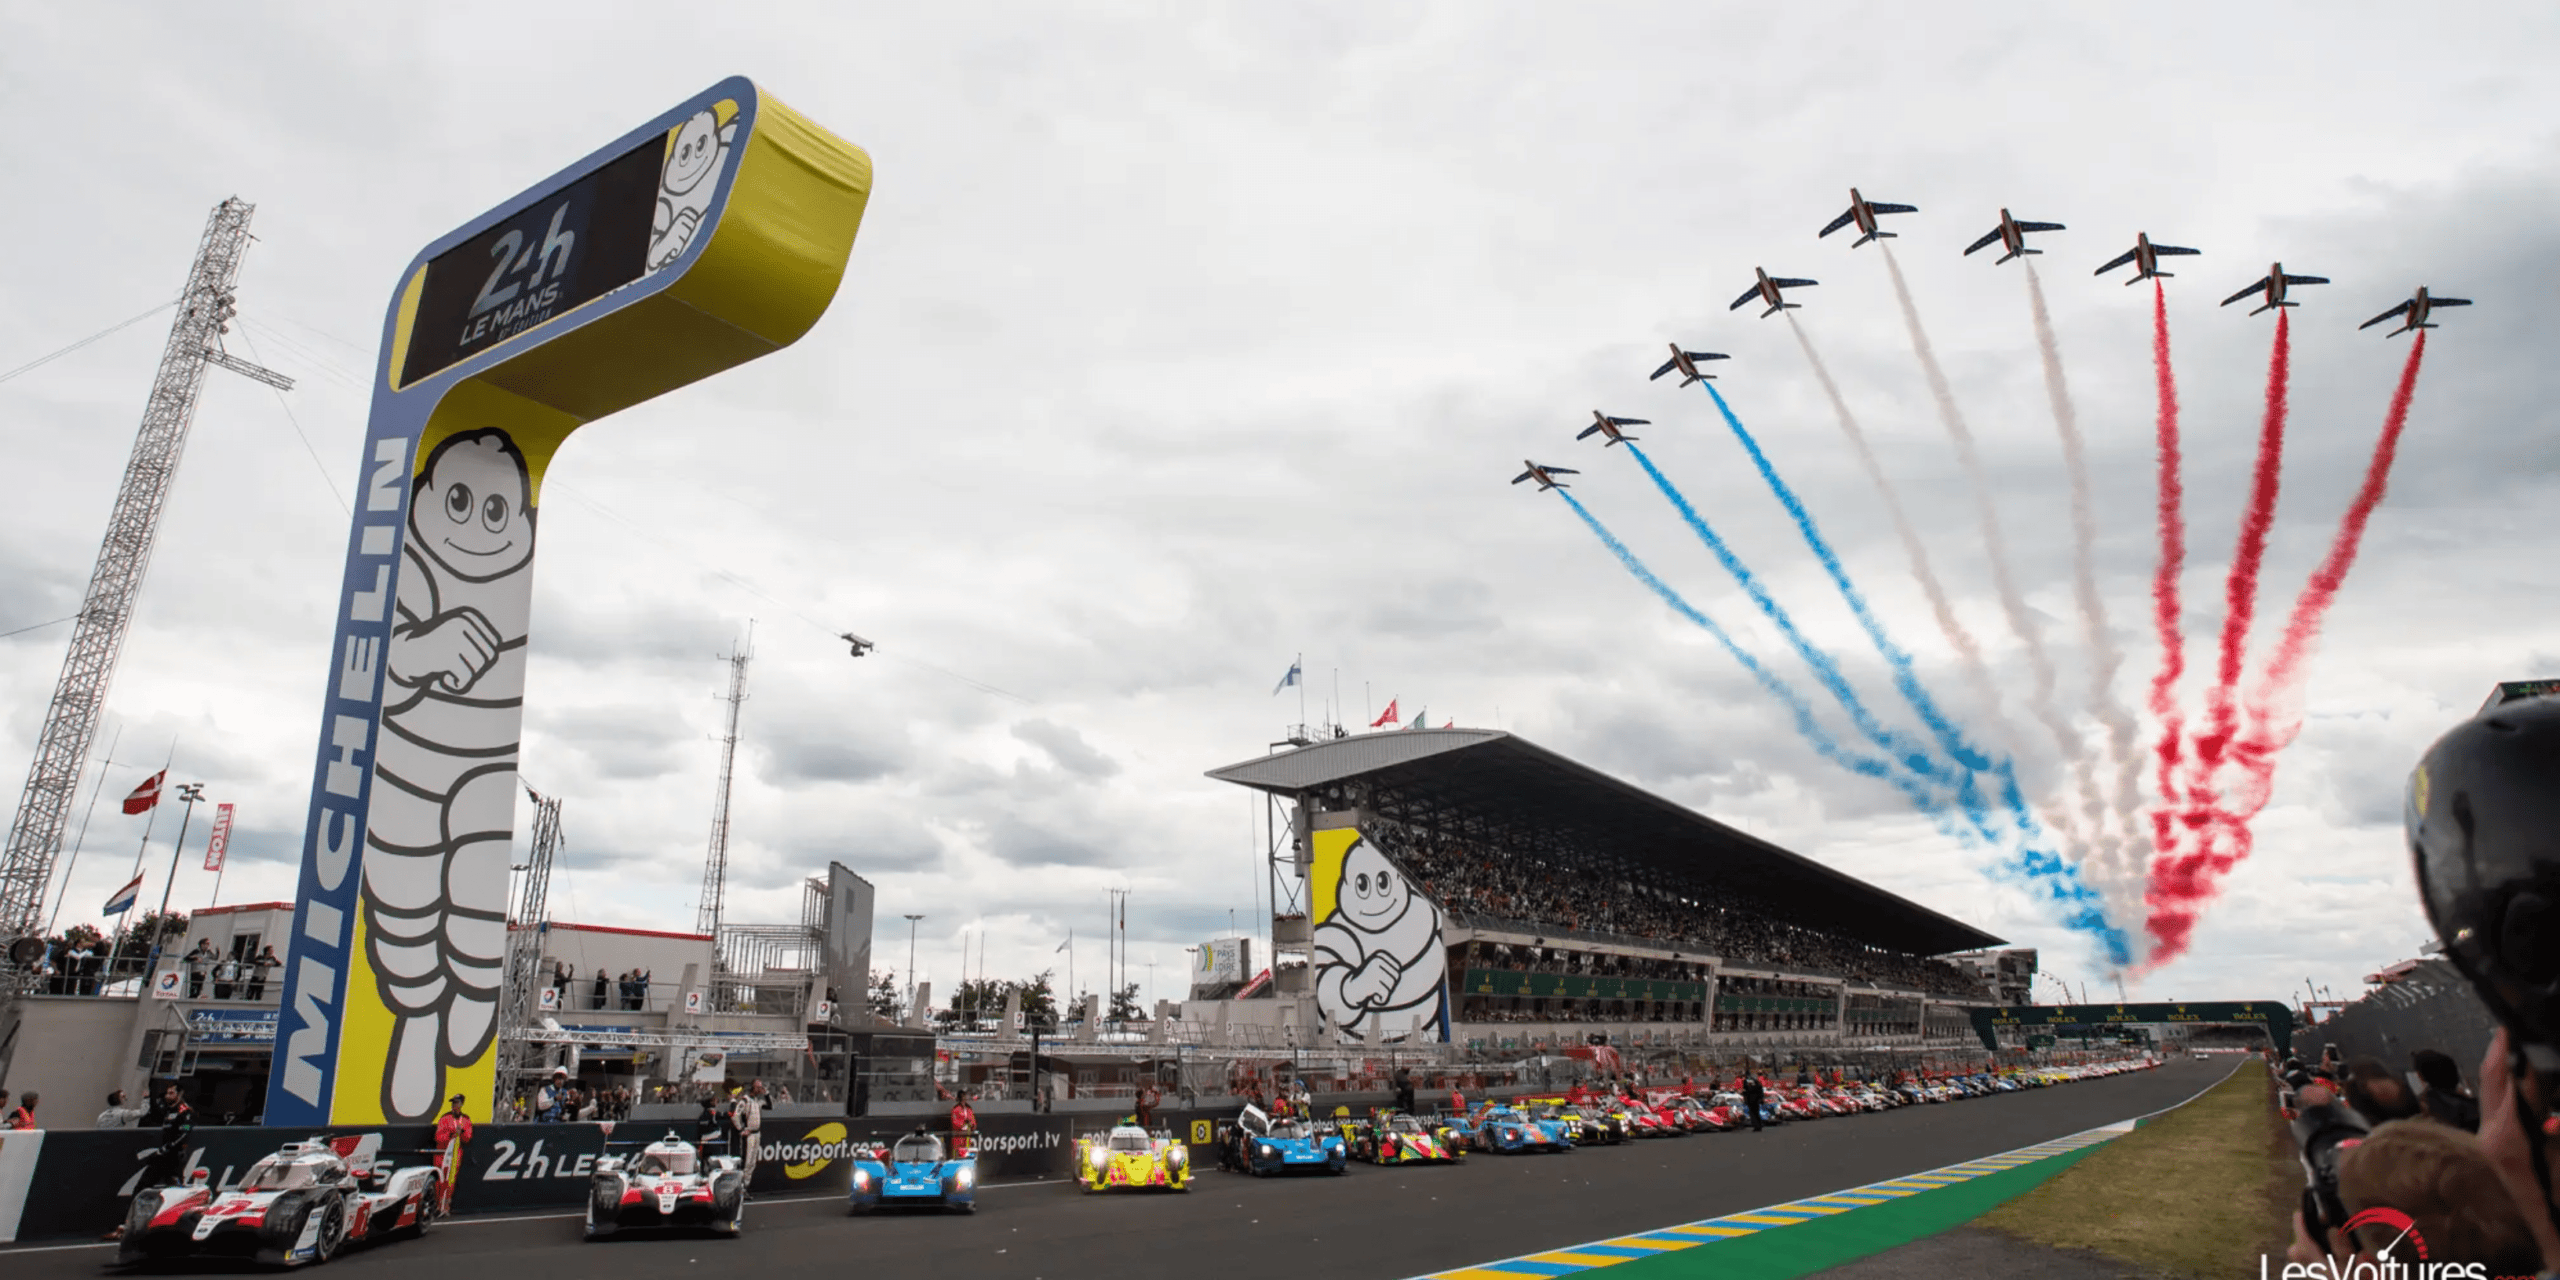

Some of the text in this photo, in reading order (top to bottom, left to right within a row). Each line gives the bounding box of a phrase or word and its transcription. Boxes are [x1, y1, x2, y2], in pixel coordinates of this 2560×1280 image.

[459, 281, 560, 346] LE MANS
[282, 436, 408, 1109] MICHELIN
[482, 1138, 550, 1181] 24h
[554, 1153, 596, 1177] LE
[970, 1131, 1060, 1155] otorsport.tv
